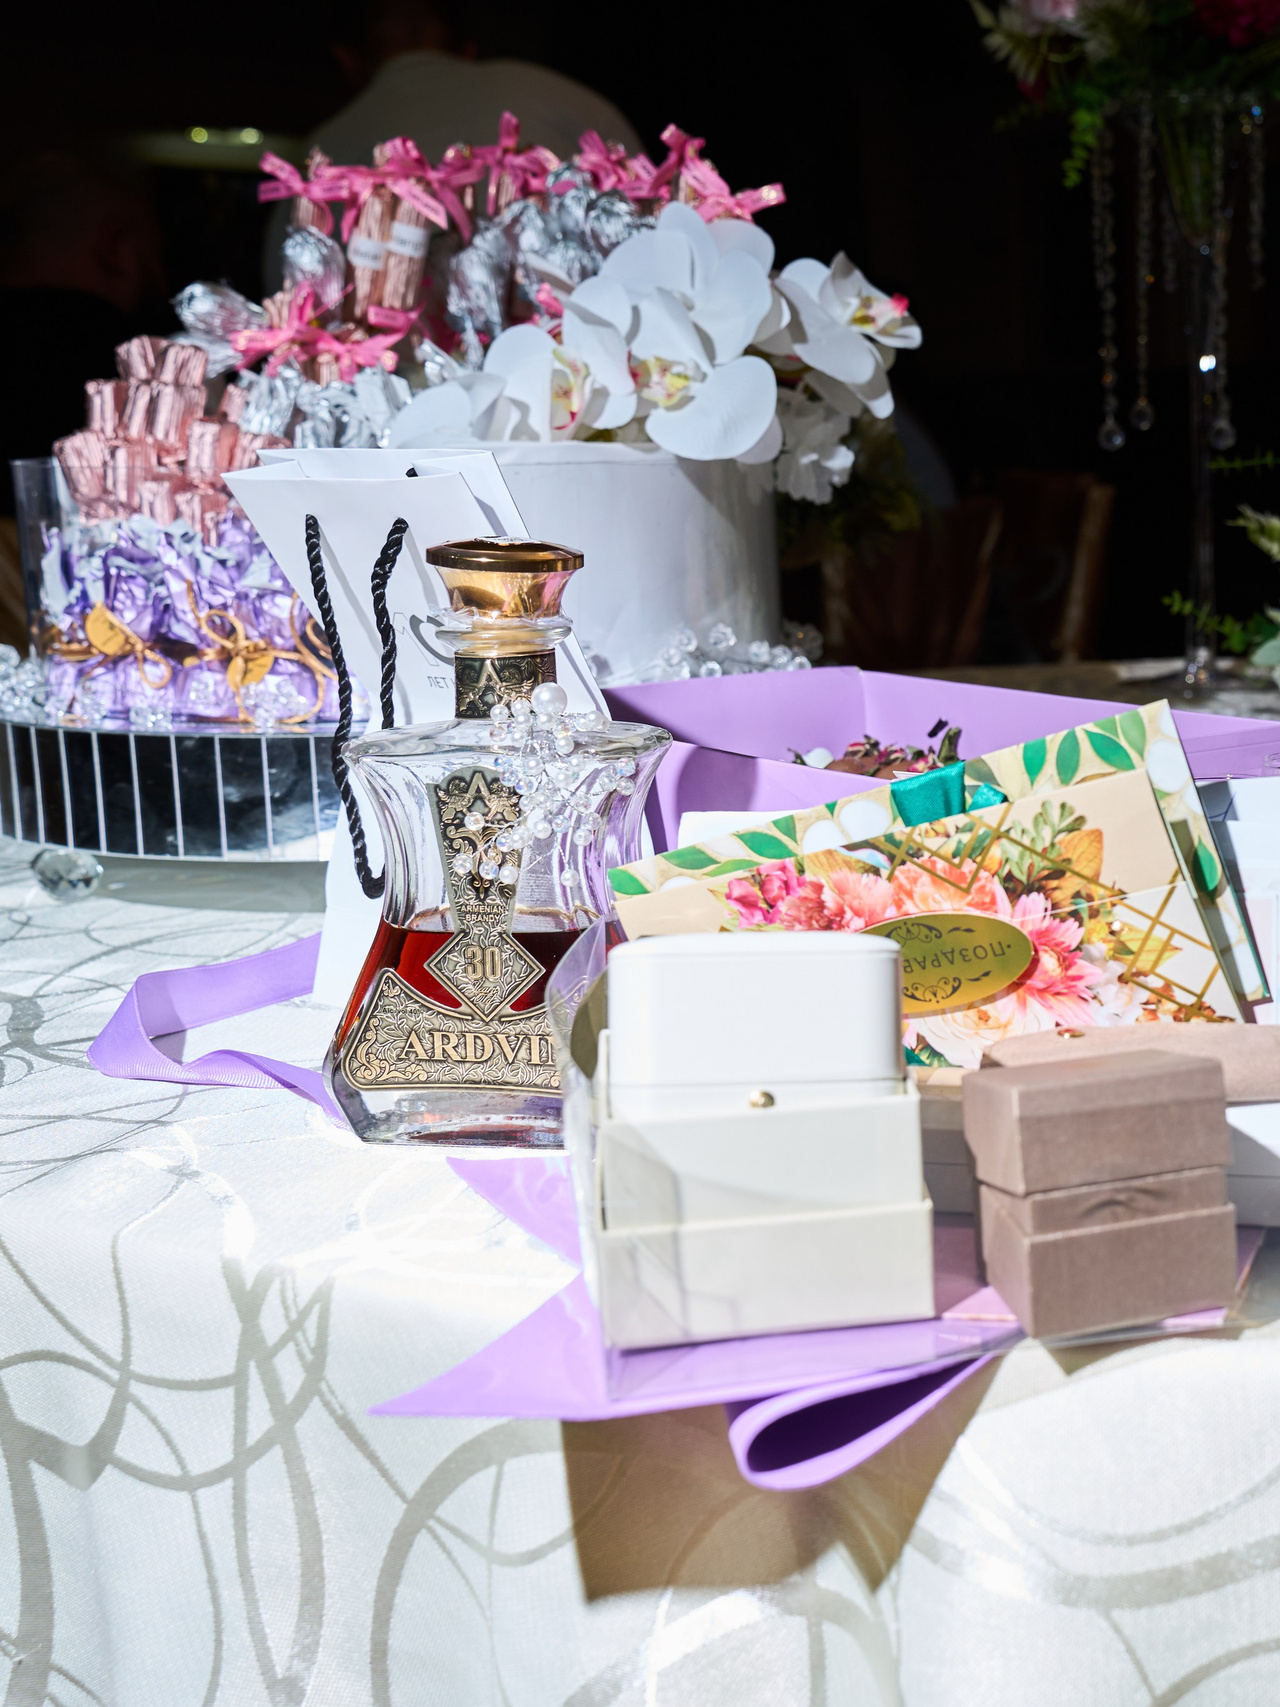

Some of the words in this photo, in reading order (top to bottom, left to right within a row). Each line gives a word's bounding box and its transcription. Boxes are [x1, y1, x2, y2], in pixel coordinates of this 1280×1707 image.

[460, 905, 504, 914] ARMENIAN
[465, 914, 501, 922] BRANDY
[465, 945, 503, 983] 30
